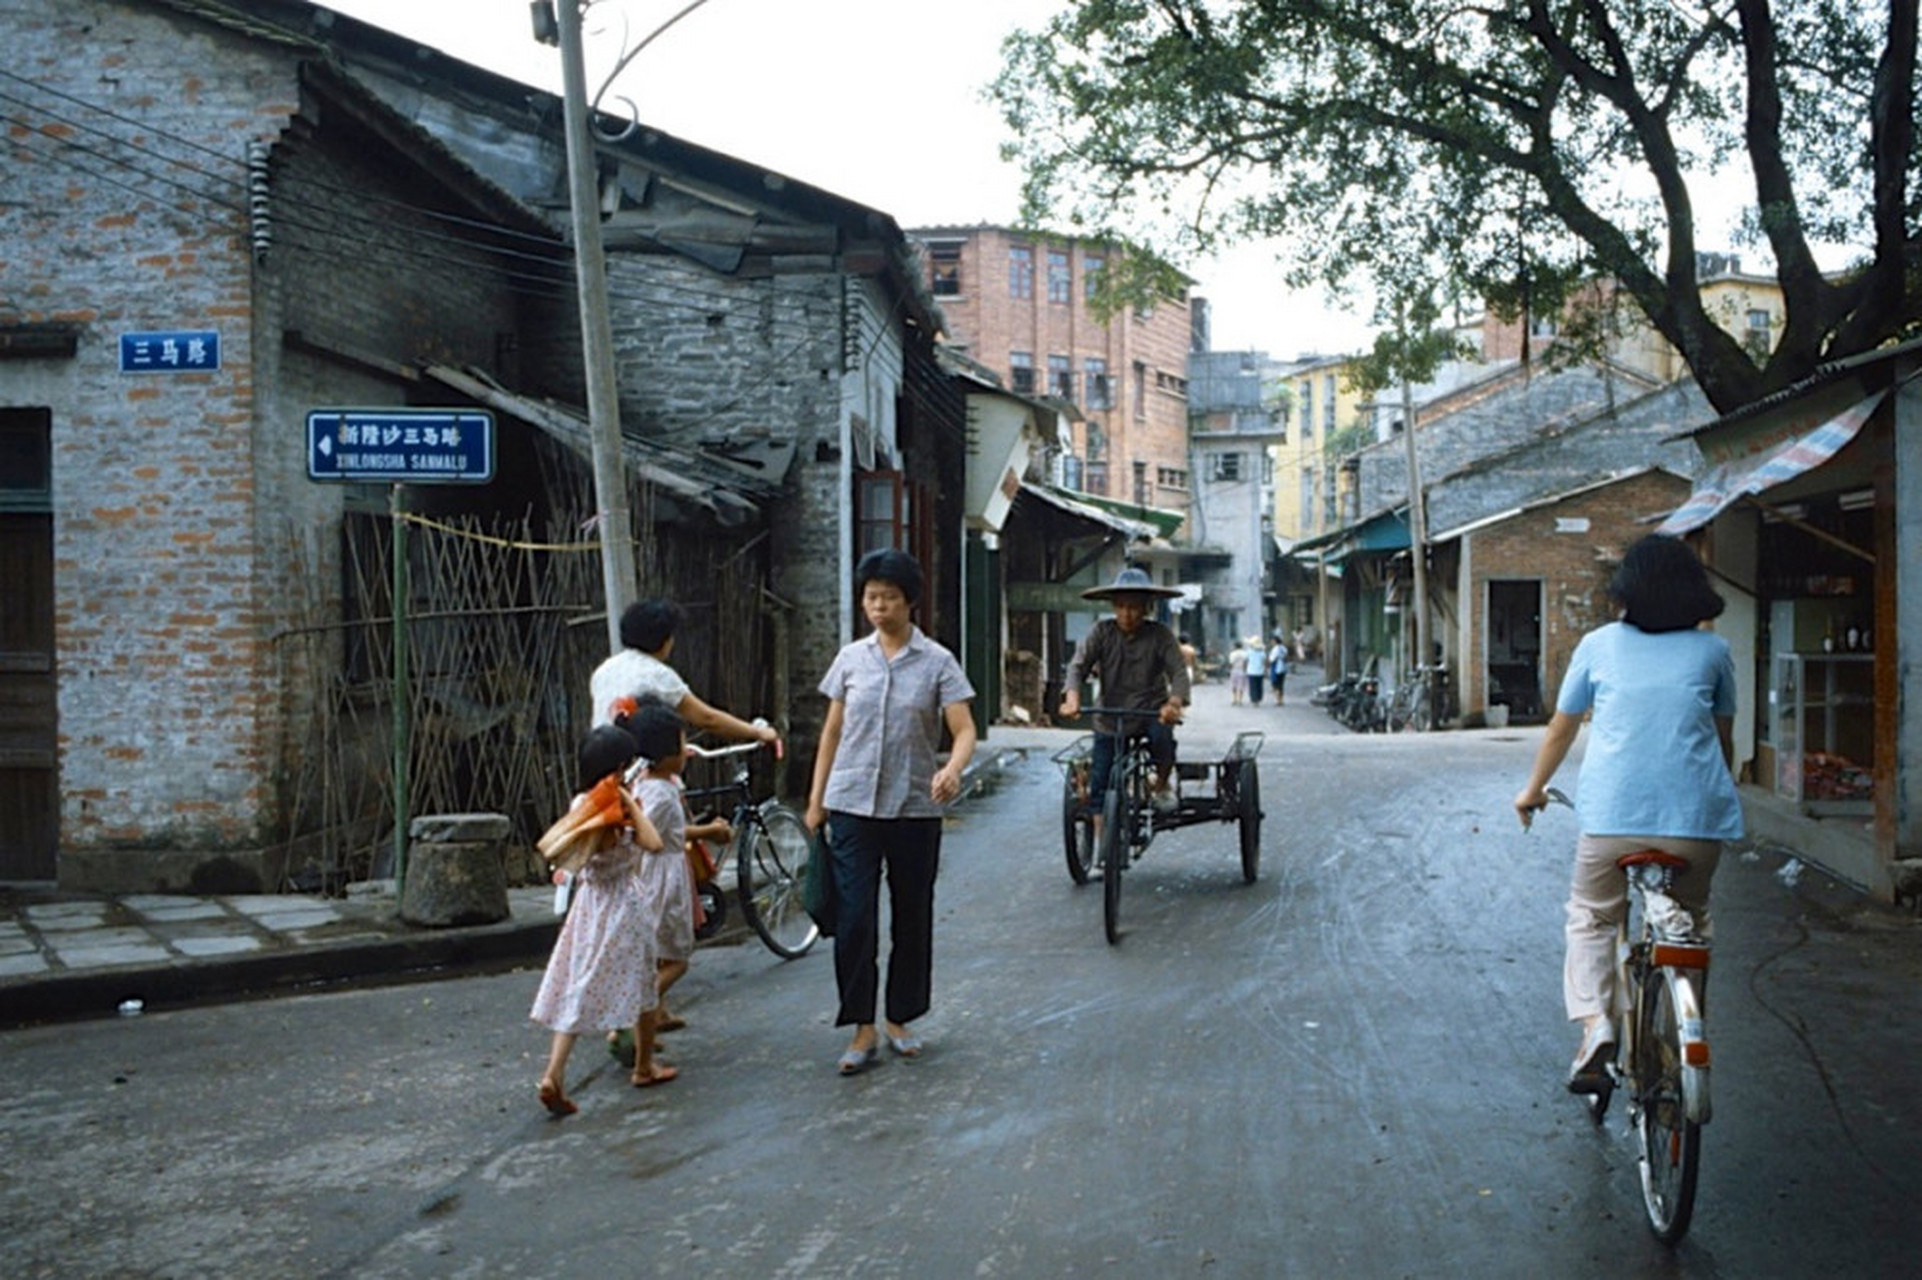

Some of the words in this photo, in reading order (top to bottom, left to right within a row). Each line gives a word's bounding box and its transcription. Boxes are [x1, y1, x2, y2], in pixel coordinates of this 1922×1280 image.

[133, 337, 207, 366] 三马路
[338, 424, 462, 447] 新隆沙三马路
[336, 453, 406, 469] XINLONGSHA
[411, 453, 468, 471] SANMALU
